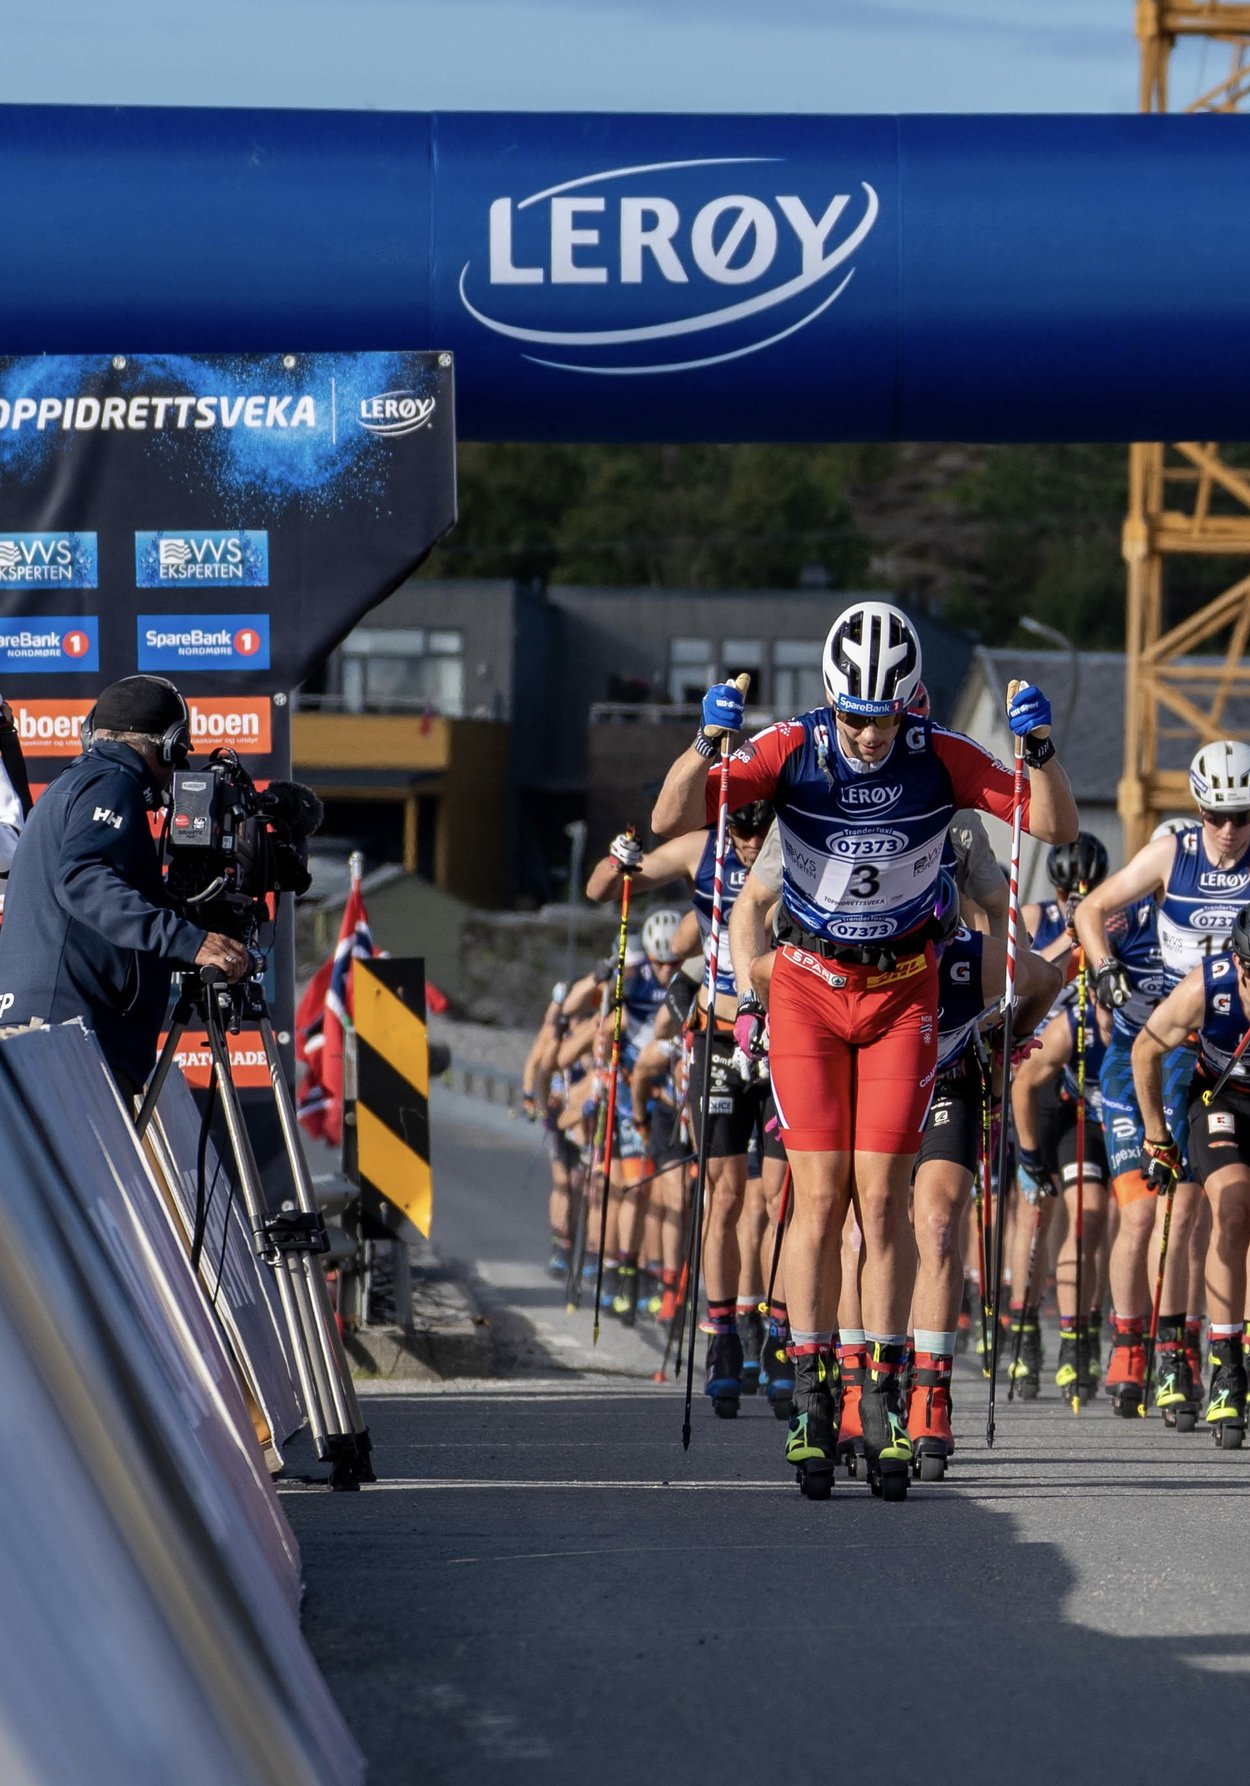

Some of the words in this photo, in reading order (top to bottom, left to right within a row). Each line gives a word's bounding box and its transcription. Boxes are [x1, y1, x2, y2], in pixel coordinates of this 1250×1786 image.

[489, 194, 852, 285] LERØY
[0, 396, 316, 431] PPIDRETTSVEKA
[360, 398, 434, 420] LERØY
[20, 540, 72, 565] VVS
[190, 539, 242, 563] VVS
[0, 565, 72, 581] KSPERTEN
[159, 563, 243, 579] EKSPERTEN
[0, 631, 60, 648] areBank
[70, 634, 82, 653] 1
[146, 629, 231, 648] SpareBank
[241, 632, 253, 651] 1
[7, 648, 62, 658] NORDMØRE
[178, 646, 233, 656] NORDMØRE
[840, 696, 890, 713] SpareBank
[15, 706, 85, 738] boen
[190, 706, 260, 736] boen
[841, 785, 899, 804] LERØY
[837, 839, 899, 855] 07373
[850, 864, 880, 899] 3
[1200, 872, 1248, 887] LERØY
[837, 924, 889, 937] 07373
[1199, 916, 1234, 927] 0737
[792, 950, 831, 980] SPAR
[178, 1052, 268, 1066] GATRADE
[919, 1065, 938, 1088] CRAF
